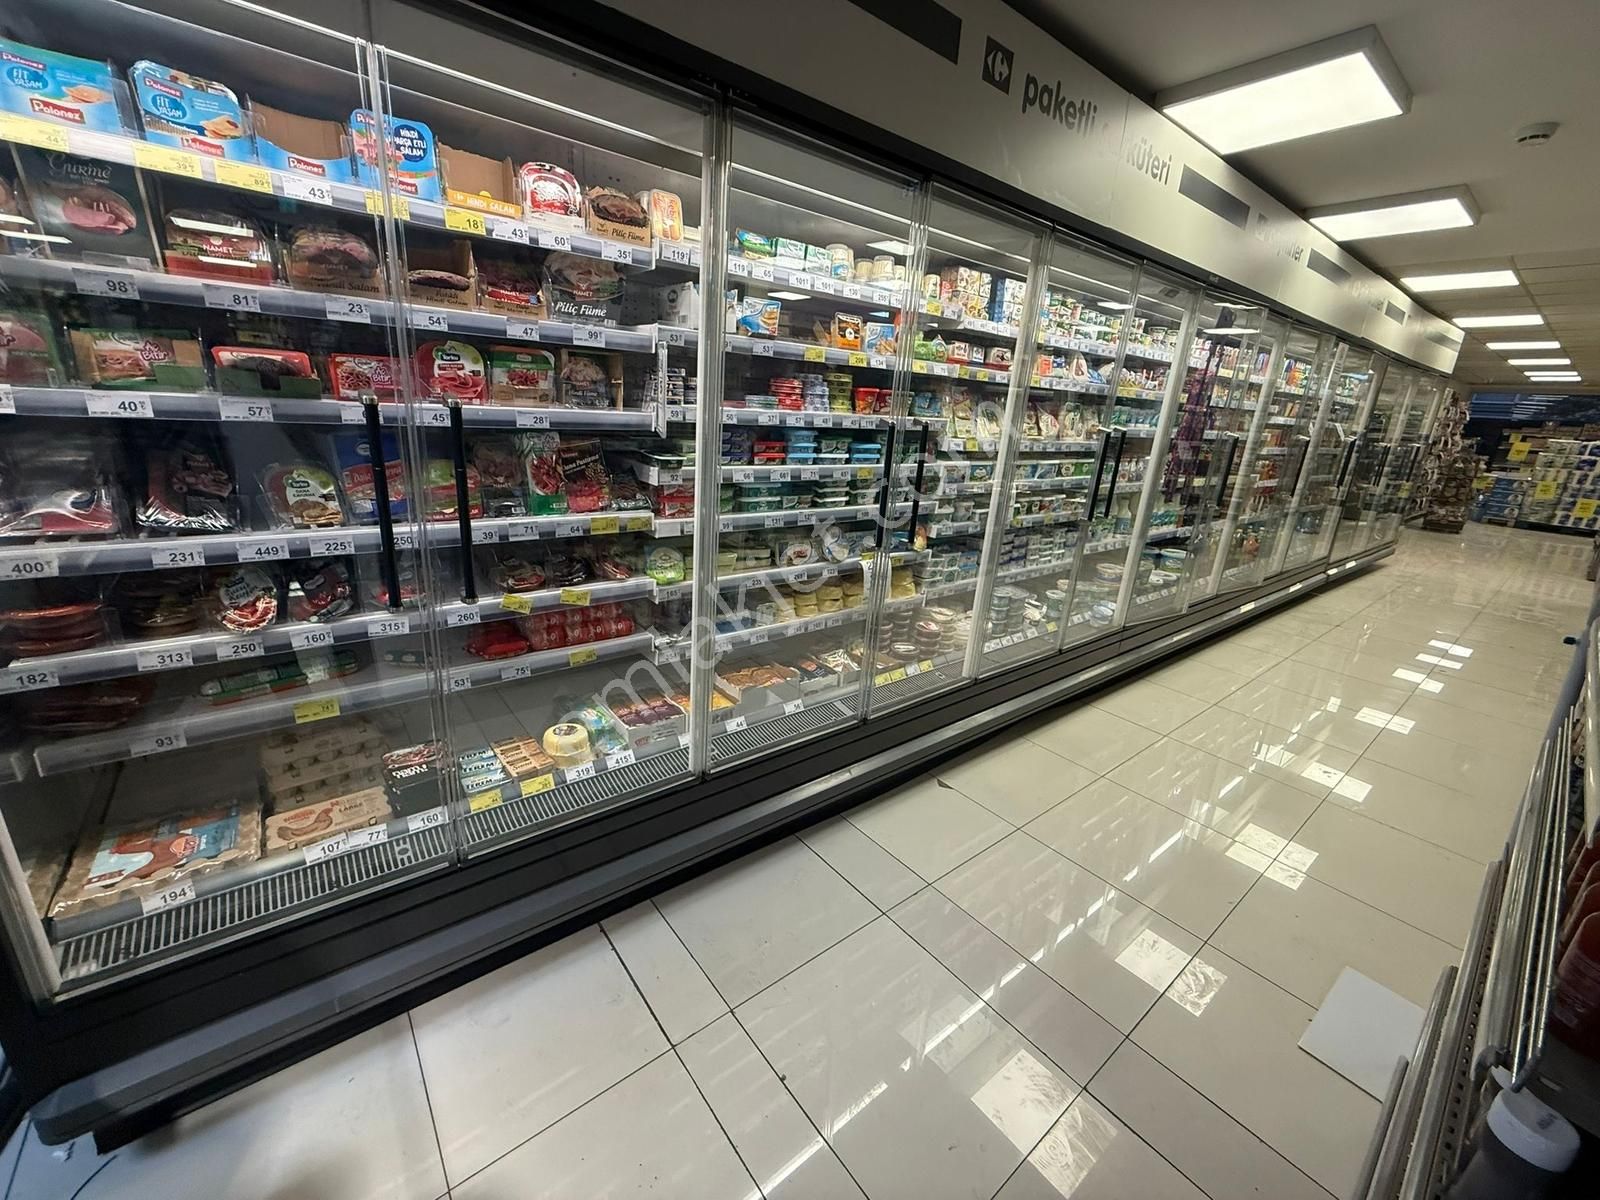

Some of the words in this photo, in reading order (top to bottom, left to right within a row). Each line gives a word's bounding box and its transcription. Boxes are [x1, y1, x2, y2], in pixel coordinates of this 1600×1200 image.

[32, 100, 80, 120] Polonez
[1022, 72, 1098, 138] paketli
[289, 157, 324, 174] Polonez
[308, 187, 325, 199] 43
[466, 218, 479, 230] 18
[511, 228, 524, 239] 43
[611, 228, 627, 240] Piliç
[628, 230, 646, 242] Füme
[554, 236, 566, 246] 60
[203, 244, 235, 254] NAMET
[617, 249, 629, 260] 35
[671, 249, 686, 260] 119
[106, 279, 129, 293] 98
[232, 294, 250, 306] 81
[348, 302, 364, 314] 23
[554, 301, 578, 316] Piliç
[580, 304, 607, 317] Füme
[428, 315, 442, 326] 54
[522, 327, 534, 337] 47
[587, 330, 599, 340] 99
[117, 400, 138, 412] 40
[247, 406, 264, 417] 57
[431, 412, 445, 423] 45
[532, 415, 544, 425] 28
[482, 531, 494, 540] 39
[523, 525, 534, 534] 71
[570, 526, 580, 534] 64
[324, 541, 348, 552] 225
[393, 536, 412, 546] 250
[168, 551, 195, 563] 231
[255, 545, 280, 557] 449
[11, 562, 45, 574] 400
[457, 612, 475, 622] 260
[380, 622, 400, 632] 315
[304, 632, 326, 644] 160
[231, 643, 256, 655] 250
[157, 653, 184, 665] 313
[515, 666, 526, 675] 75
[15, 672, 48, 686] 182
[453, 678, 466, 688] 53
[155, 736, 174, 748] 93
[614, 755, 630, 765] 415
[575, 767, 590, 779] 319
[420, 813, 439, 826] 160
[367, 830, 382, 841] 77
[320, 841, 341, 855] 107
[160, 887, 187, 903] 194
